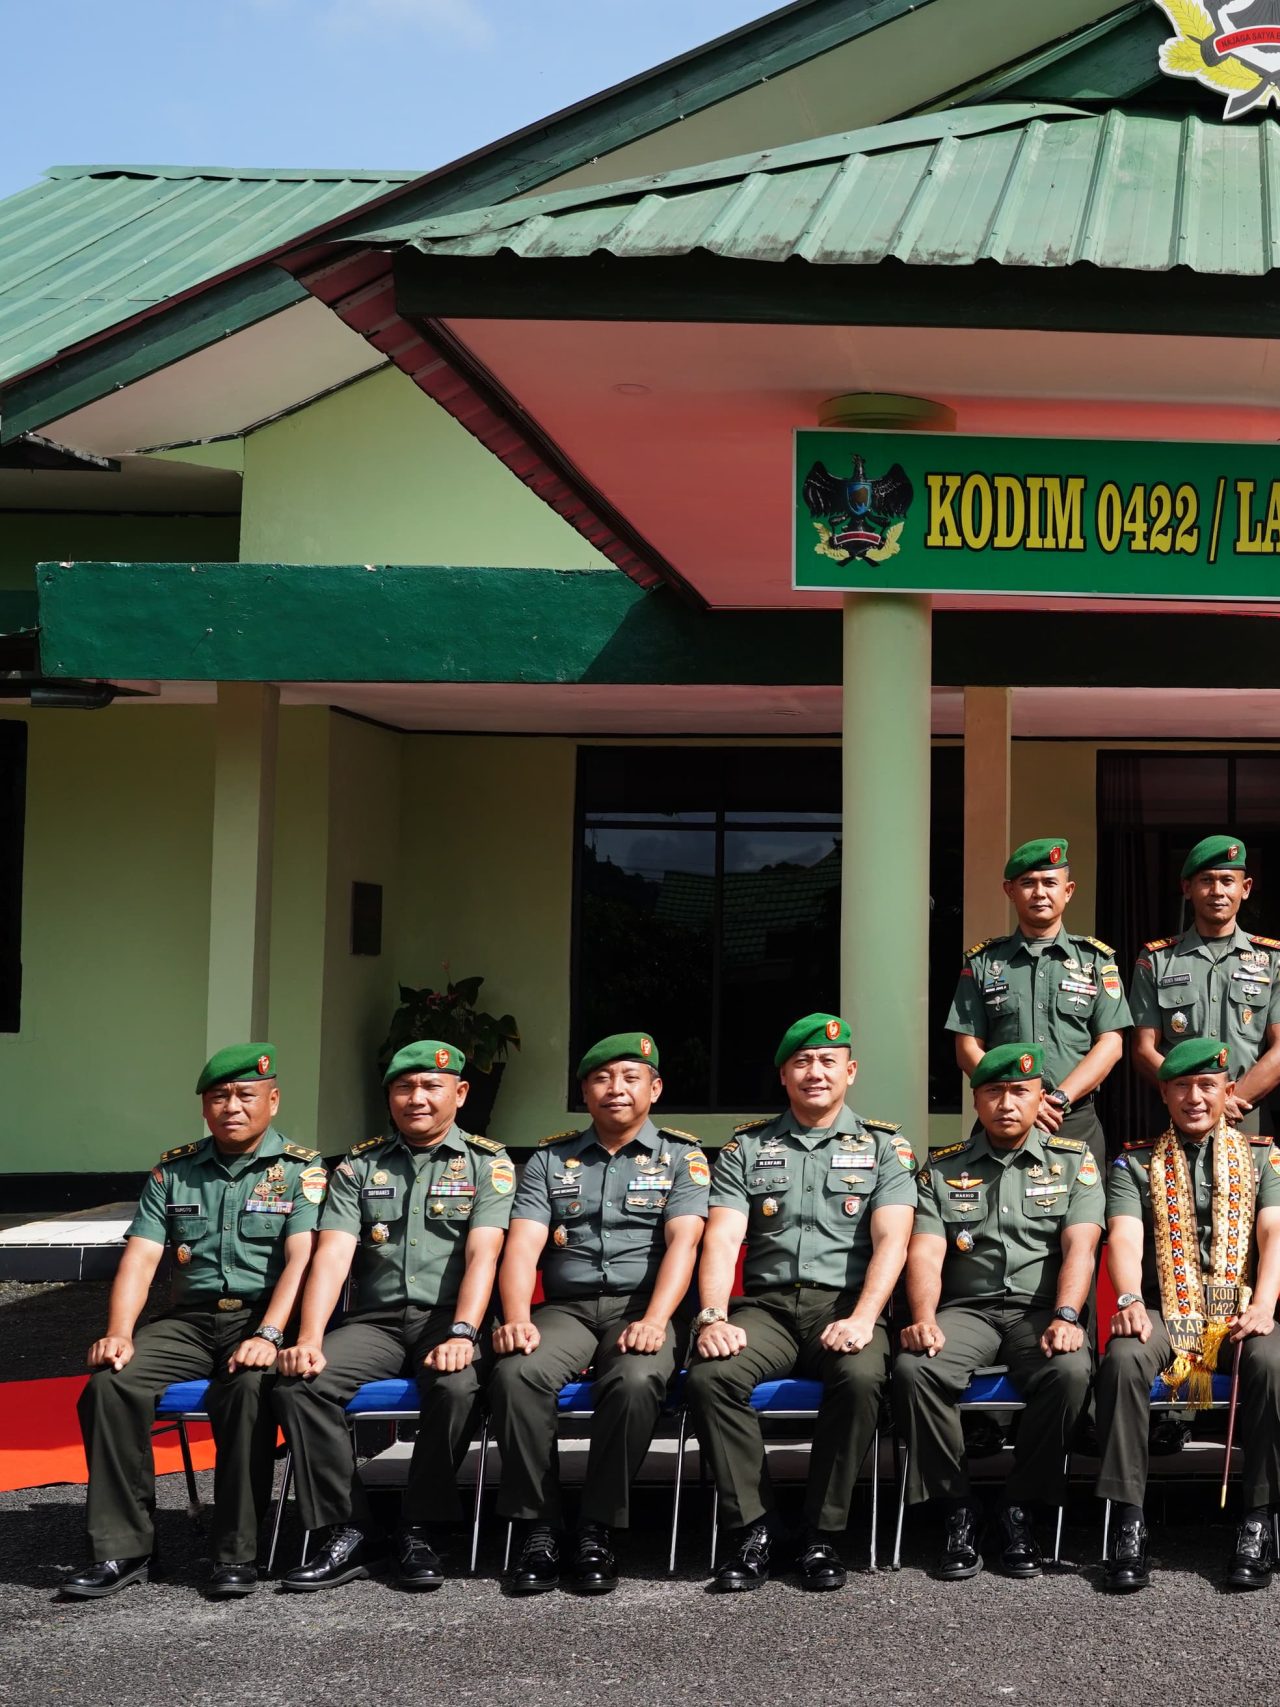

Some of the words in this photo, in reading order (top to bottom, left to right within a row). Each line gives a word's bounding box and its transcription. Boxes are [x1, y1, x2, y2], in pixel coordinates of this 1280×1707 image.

[1252, 31, 1274, 41] SATYA
[925, 472, 1086, 551] KODIM
[1098, 481, 1199, 554] 0422
